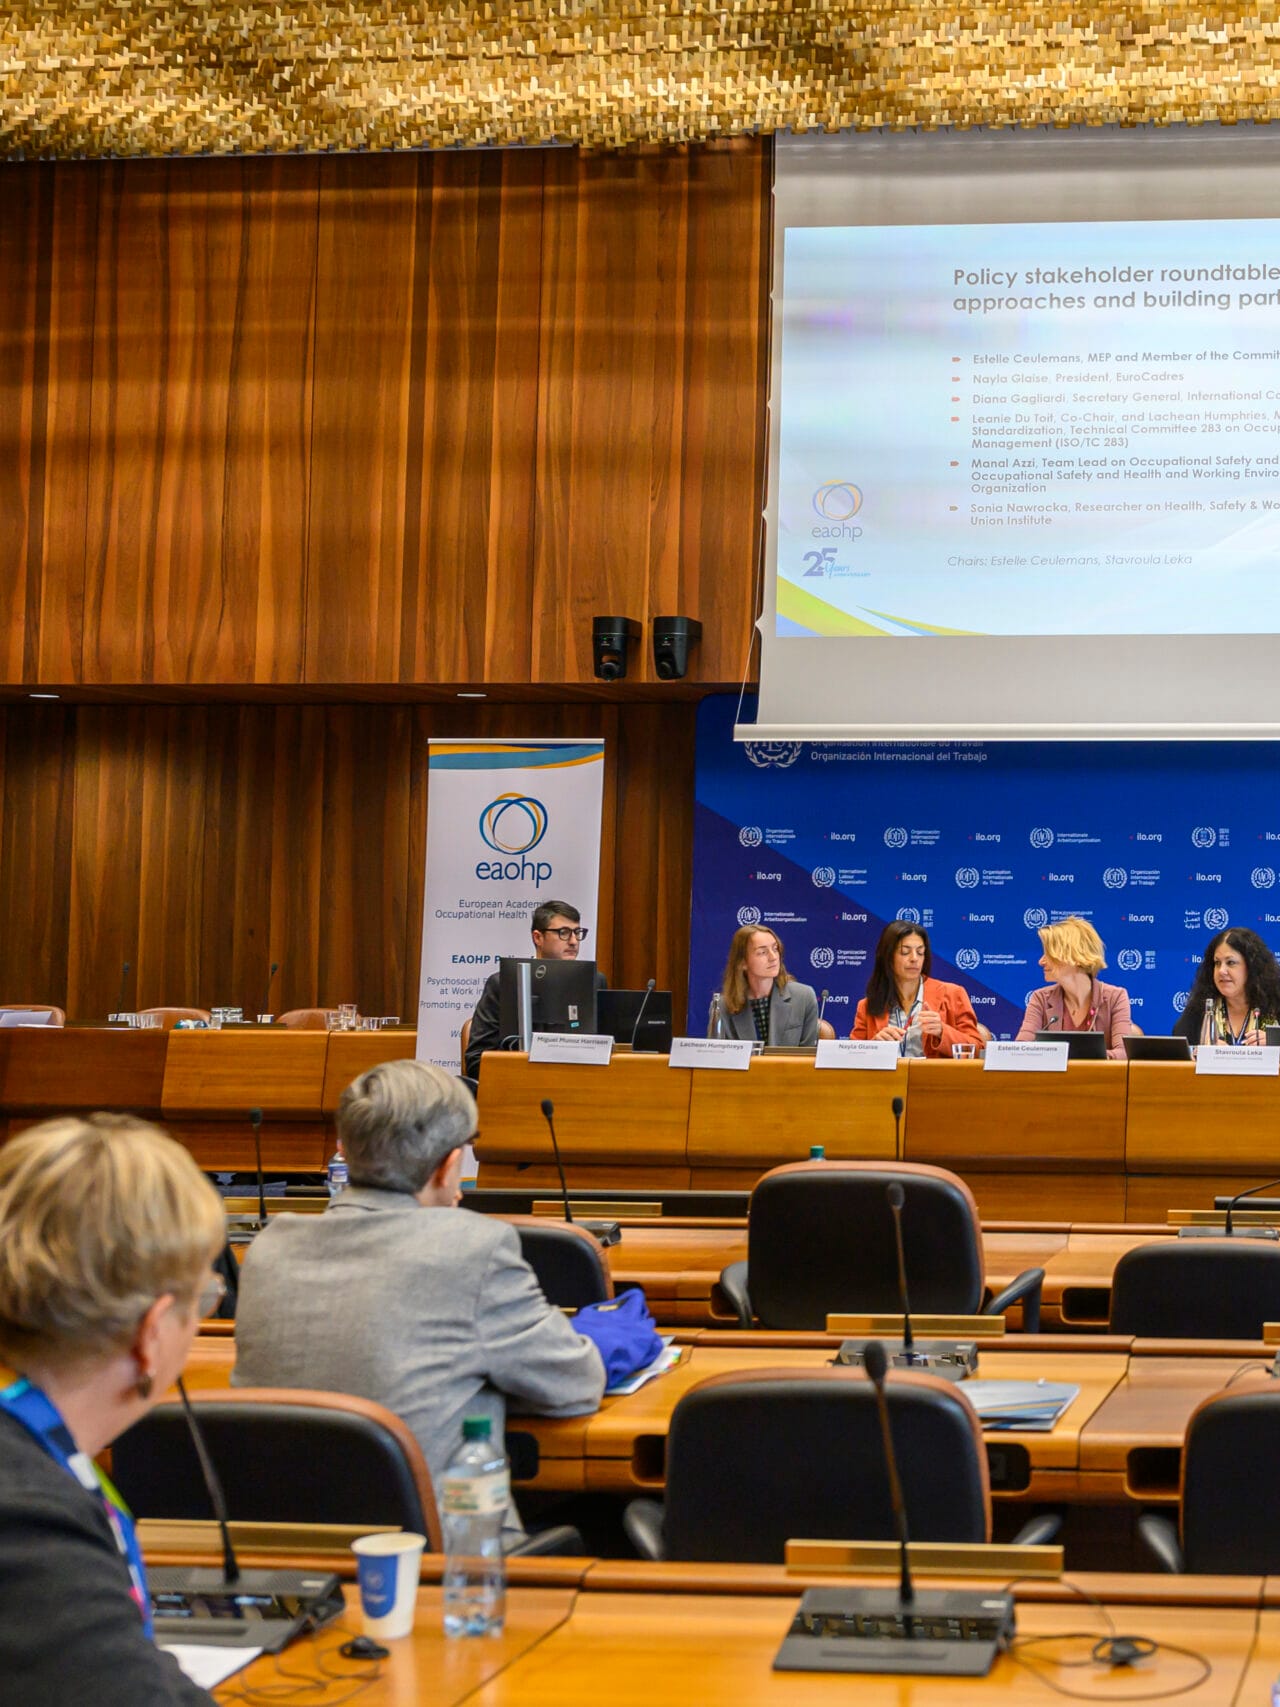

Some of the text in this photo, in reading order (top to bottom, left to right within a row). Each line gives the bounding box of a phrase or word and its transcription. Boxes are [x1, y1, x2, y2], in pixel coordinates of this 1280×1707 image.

[954, 268, 1018, 290] Policy
[1024, 266, 1154, 284] stakeholder
[952, 292, 1085, 315] approaches
[1093, 291, 1135, 308] and
[1143, 290, 1230, 312] building
[973, 353, 1010, 364] Estelle
[1013, 352, 1083, 365] Ceulemans,
[1087, 352, 1112, 363] MEP
[1115, 352, 1138, 362] and
[1141, 351, 1192, 362] Member
[1195, 351, 1207, 361] of
[1210, 350, 1228, 361] the
[972, 373, 1008, 386] Nayla
[1055, 372, 1112, 384] President,
[1116, 371, 1184, 382] EuroCadres
[972, 393, 1007, 404] Diana
[1072, 391, 1128, 404] Secretary
[1133, 391, 1183, 403] General,
[1187, 390, 1262, 401] International
[972, 437, 1129, 451] Management (ISO/TC 283)
[971, 458, 1008, 468] Manal
[1012, 457, 1039, 469] Azzi,
[1042, 457, 1074, 468] Team
[1078, 457, 1107, 467] Lead
[1129, 456, 1212, 469] Occupational
[1215, 455, 1252, 468] Safety
[1255, 455, 1279, 465] and
[971, 470, 1053, 483] Occupational
[1056, 469, 1093, 482] Safety
[1096, 469, 1119, 479] and
[1124, 468, 1162, 479] Health
[1165, 468, 1188, 479] and
[1192, 468, 1240, 481] Working
[971, 482, 1046, 496] Organization
[970, 502, 1003, 513] Sonia
[1006, 502, 1071, 514] Nawrocka,
[1075, 501, 1142, 512] Researcher
[1164, 500, 1205, 512] Health,
[1210, 500, 1246, 513] Safety
[1250, 500, 1258, 510] &
[970, 514, 1052, 525] Union Institute
[812, 522, 862, 541] eaohp
[802, 548, 837, 576] 25
[948, 554, 1192, 567] Chairs: Estelle Ceulemans, Stavroula Leka
[811, 752, 987, 762] Organización Internacional del Trabajo
[831, 832, 855, 842] ilo.org
[1137, 833, 1162, 842] ilo.org
[476, 855, 552, 888] eaohp
[757, 872, 781, 881] ilo.org
[1049, 873, 1074, 882] ilo.org
[459, 900, 544, 909] European Academ
[435, 910, 527, 920] Occupational Health
[842, 913, 867, 922] ilo.org
[1129, 914, 1154, 923] ilo.org
[452, 956, 491, 964] EAOHP
[427, 977, 480, 986] Psychosocial
[420, 1002, 461, 1010] Promoting
